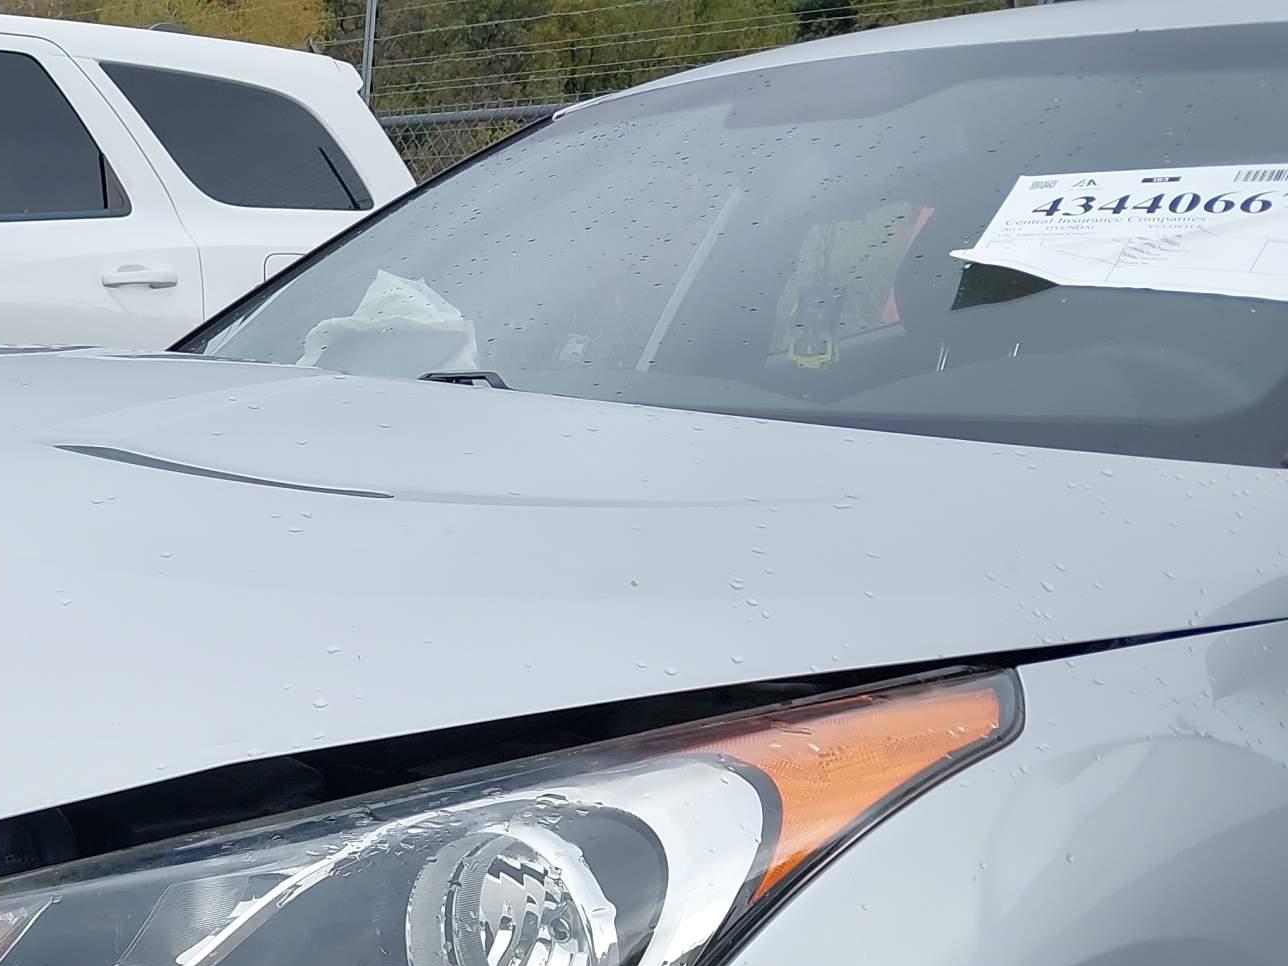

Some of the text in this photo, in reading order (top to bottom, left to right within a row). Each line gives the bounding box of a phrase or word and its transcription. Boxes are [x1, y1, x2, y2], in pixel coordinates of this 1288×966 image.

[1032, 190, 1288, 216] 4344066
[1005, 215, 1206, 226] Central Insurance Companies
